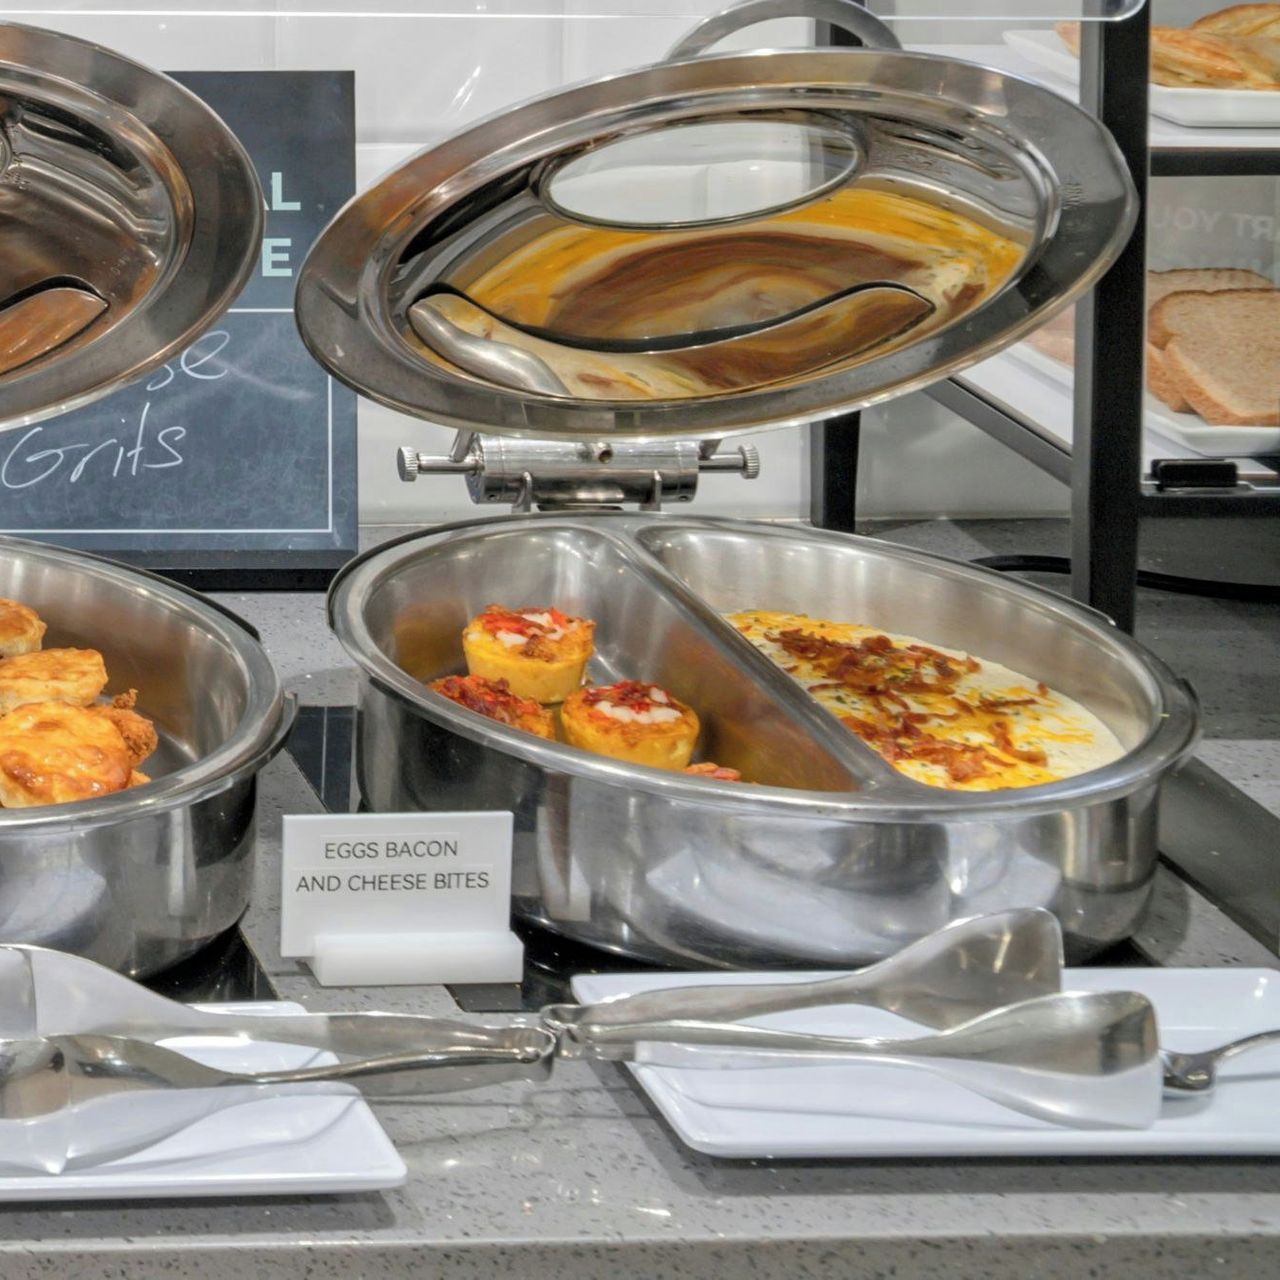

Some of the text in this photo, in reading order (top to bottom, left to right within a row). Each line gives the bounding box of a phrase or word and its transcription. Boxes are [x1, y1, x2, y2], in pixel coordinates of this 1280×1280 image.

[264, 172, 301, 211] L
[1, 403, 187, 489] Grits
[326, 841, 457, 858] EGGS BACON
[297, 872, 488, 891] AND CHEESE BITES
